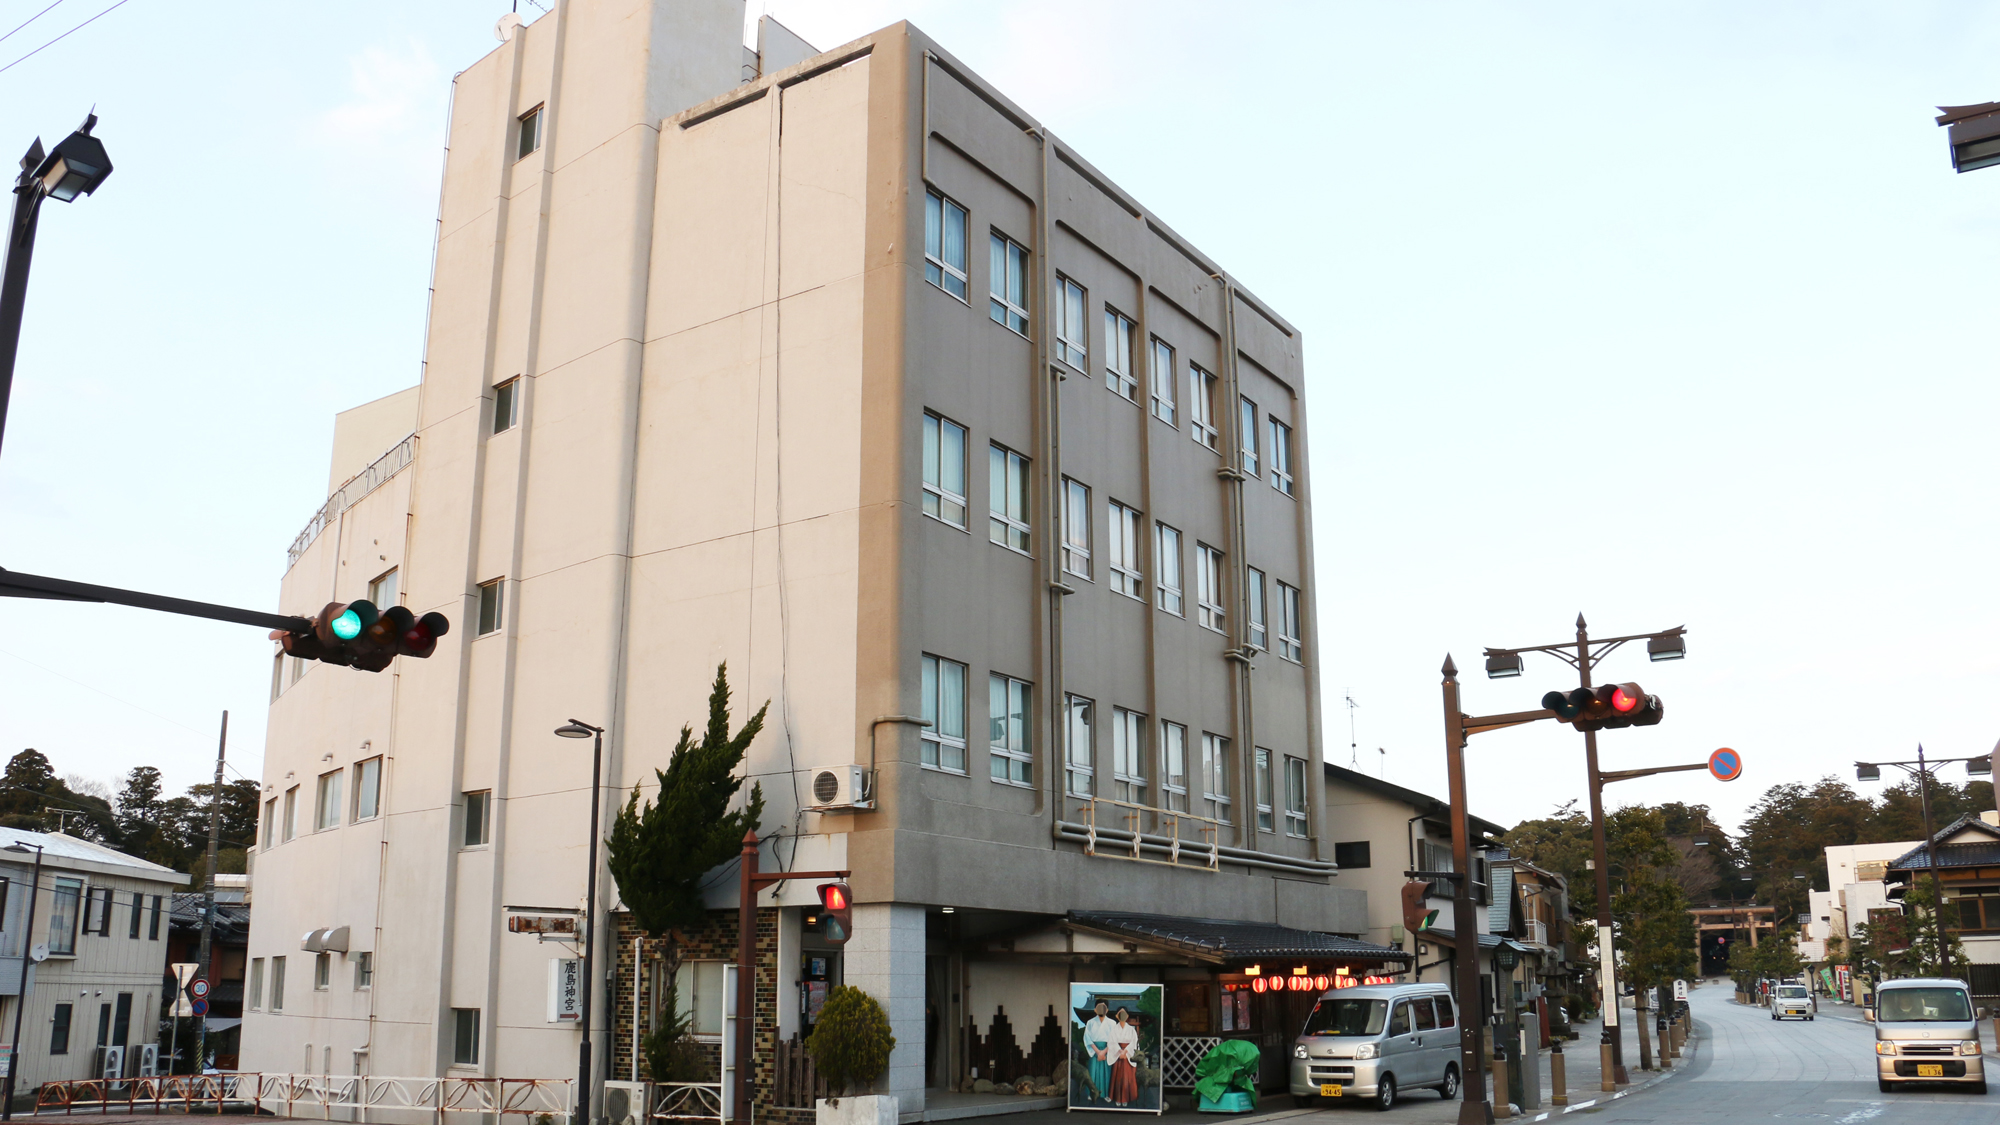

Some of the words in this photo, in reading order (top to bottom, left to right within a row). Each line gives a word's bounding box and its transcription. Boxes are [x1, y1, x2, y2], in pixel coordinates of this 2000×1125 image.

[195, 984, 206, 993] 30
[564, 960, 577, 1011] 鹿島神宮
